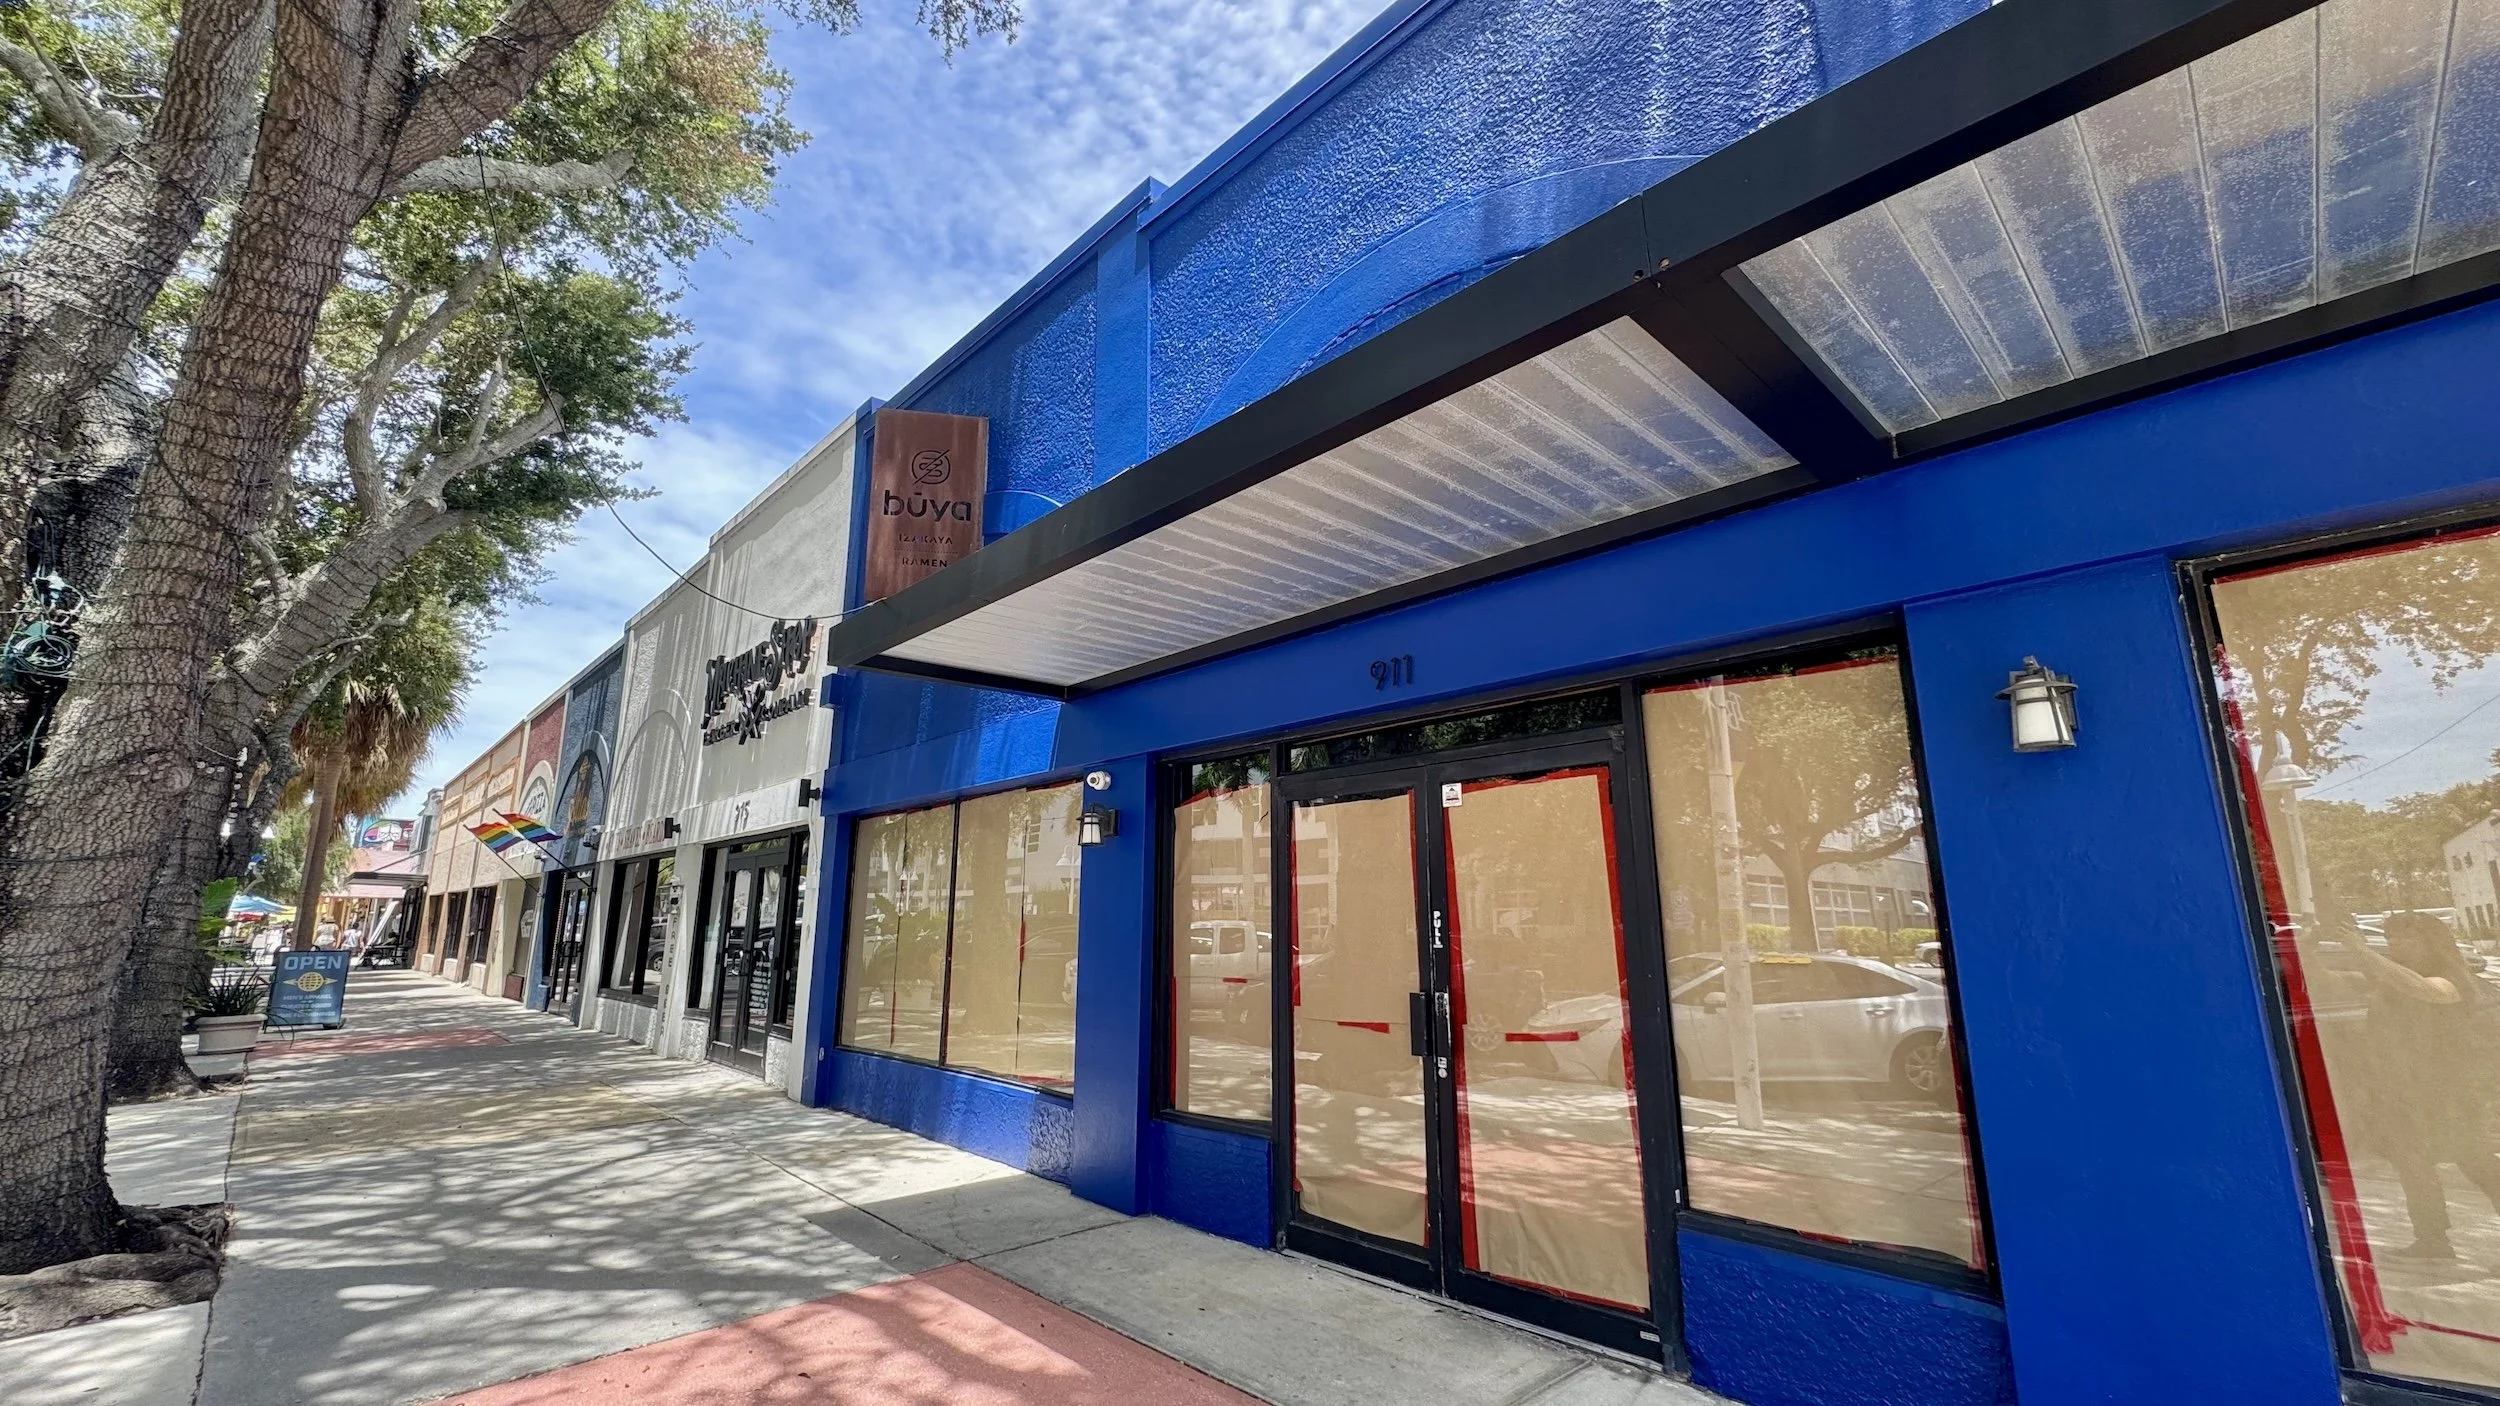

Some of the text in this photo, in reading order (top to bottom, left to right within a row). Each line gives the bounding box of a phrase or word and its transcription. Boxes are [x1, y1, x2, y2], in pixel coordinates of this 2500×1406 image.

[899, 533, 953, 545] IZAKAYA
[902, 558, 948, 568] RAMEN
[1370, 654, 1413, 690] 911
[1433, 911, 1443, 948] PULL
[284, 956, 342, 970] OPEN
